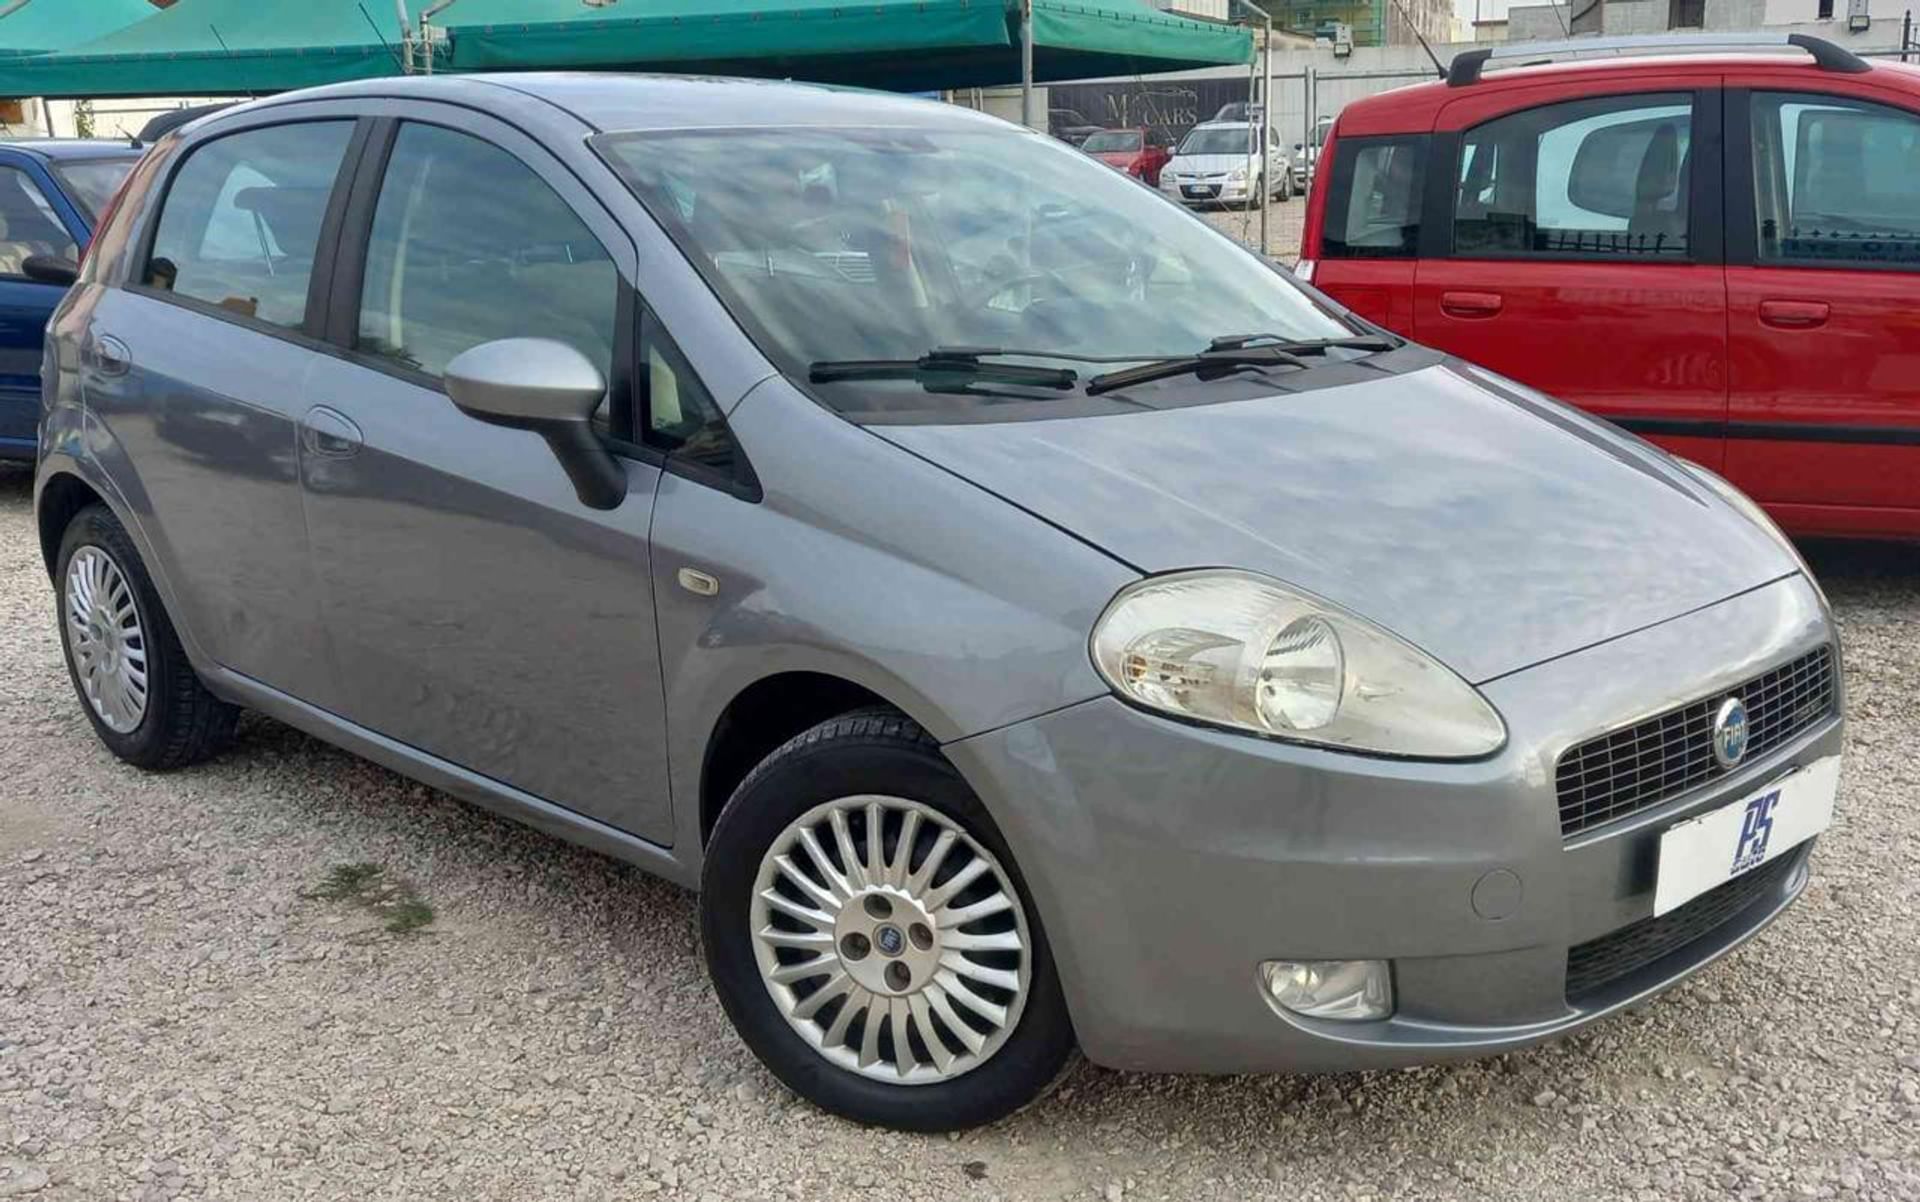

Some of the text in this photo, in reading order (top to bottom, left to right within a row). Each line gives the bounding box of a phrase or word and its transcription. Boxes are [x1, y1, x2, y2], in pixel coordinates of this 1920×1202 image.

[1143, 108, 1198, 126] CARS
[1723, 720, 1745, 749] FIAT
[1735, 789, 1781, 858] PS
